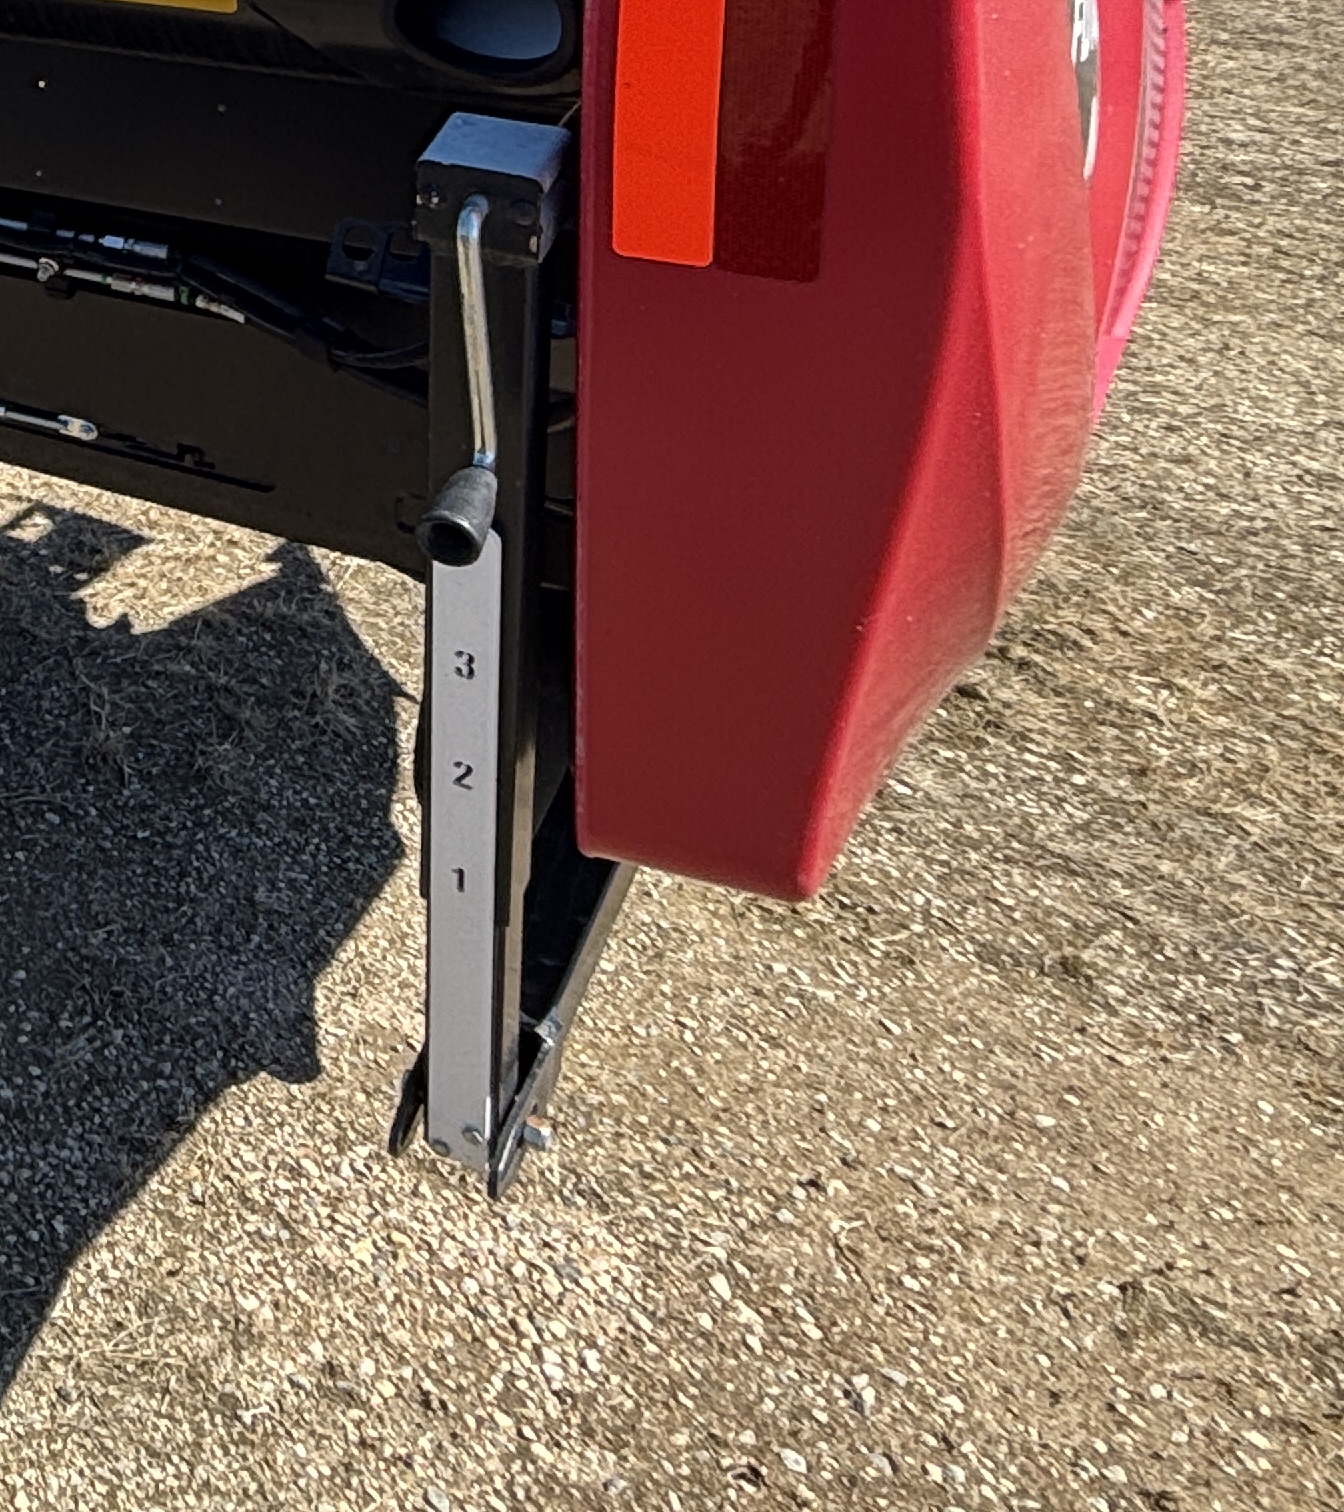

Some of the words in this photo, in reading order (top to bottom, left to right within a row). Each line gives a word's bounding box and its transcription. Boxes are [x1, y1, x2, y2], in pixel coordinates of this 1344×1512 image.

[454, 650, 475, 679] 3
[452, 761, 474, 791] 2
[451, 867, 465, 893] 1
